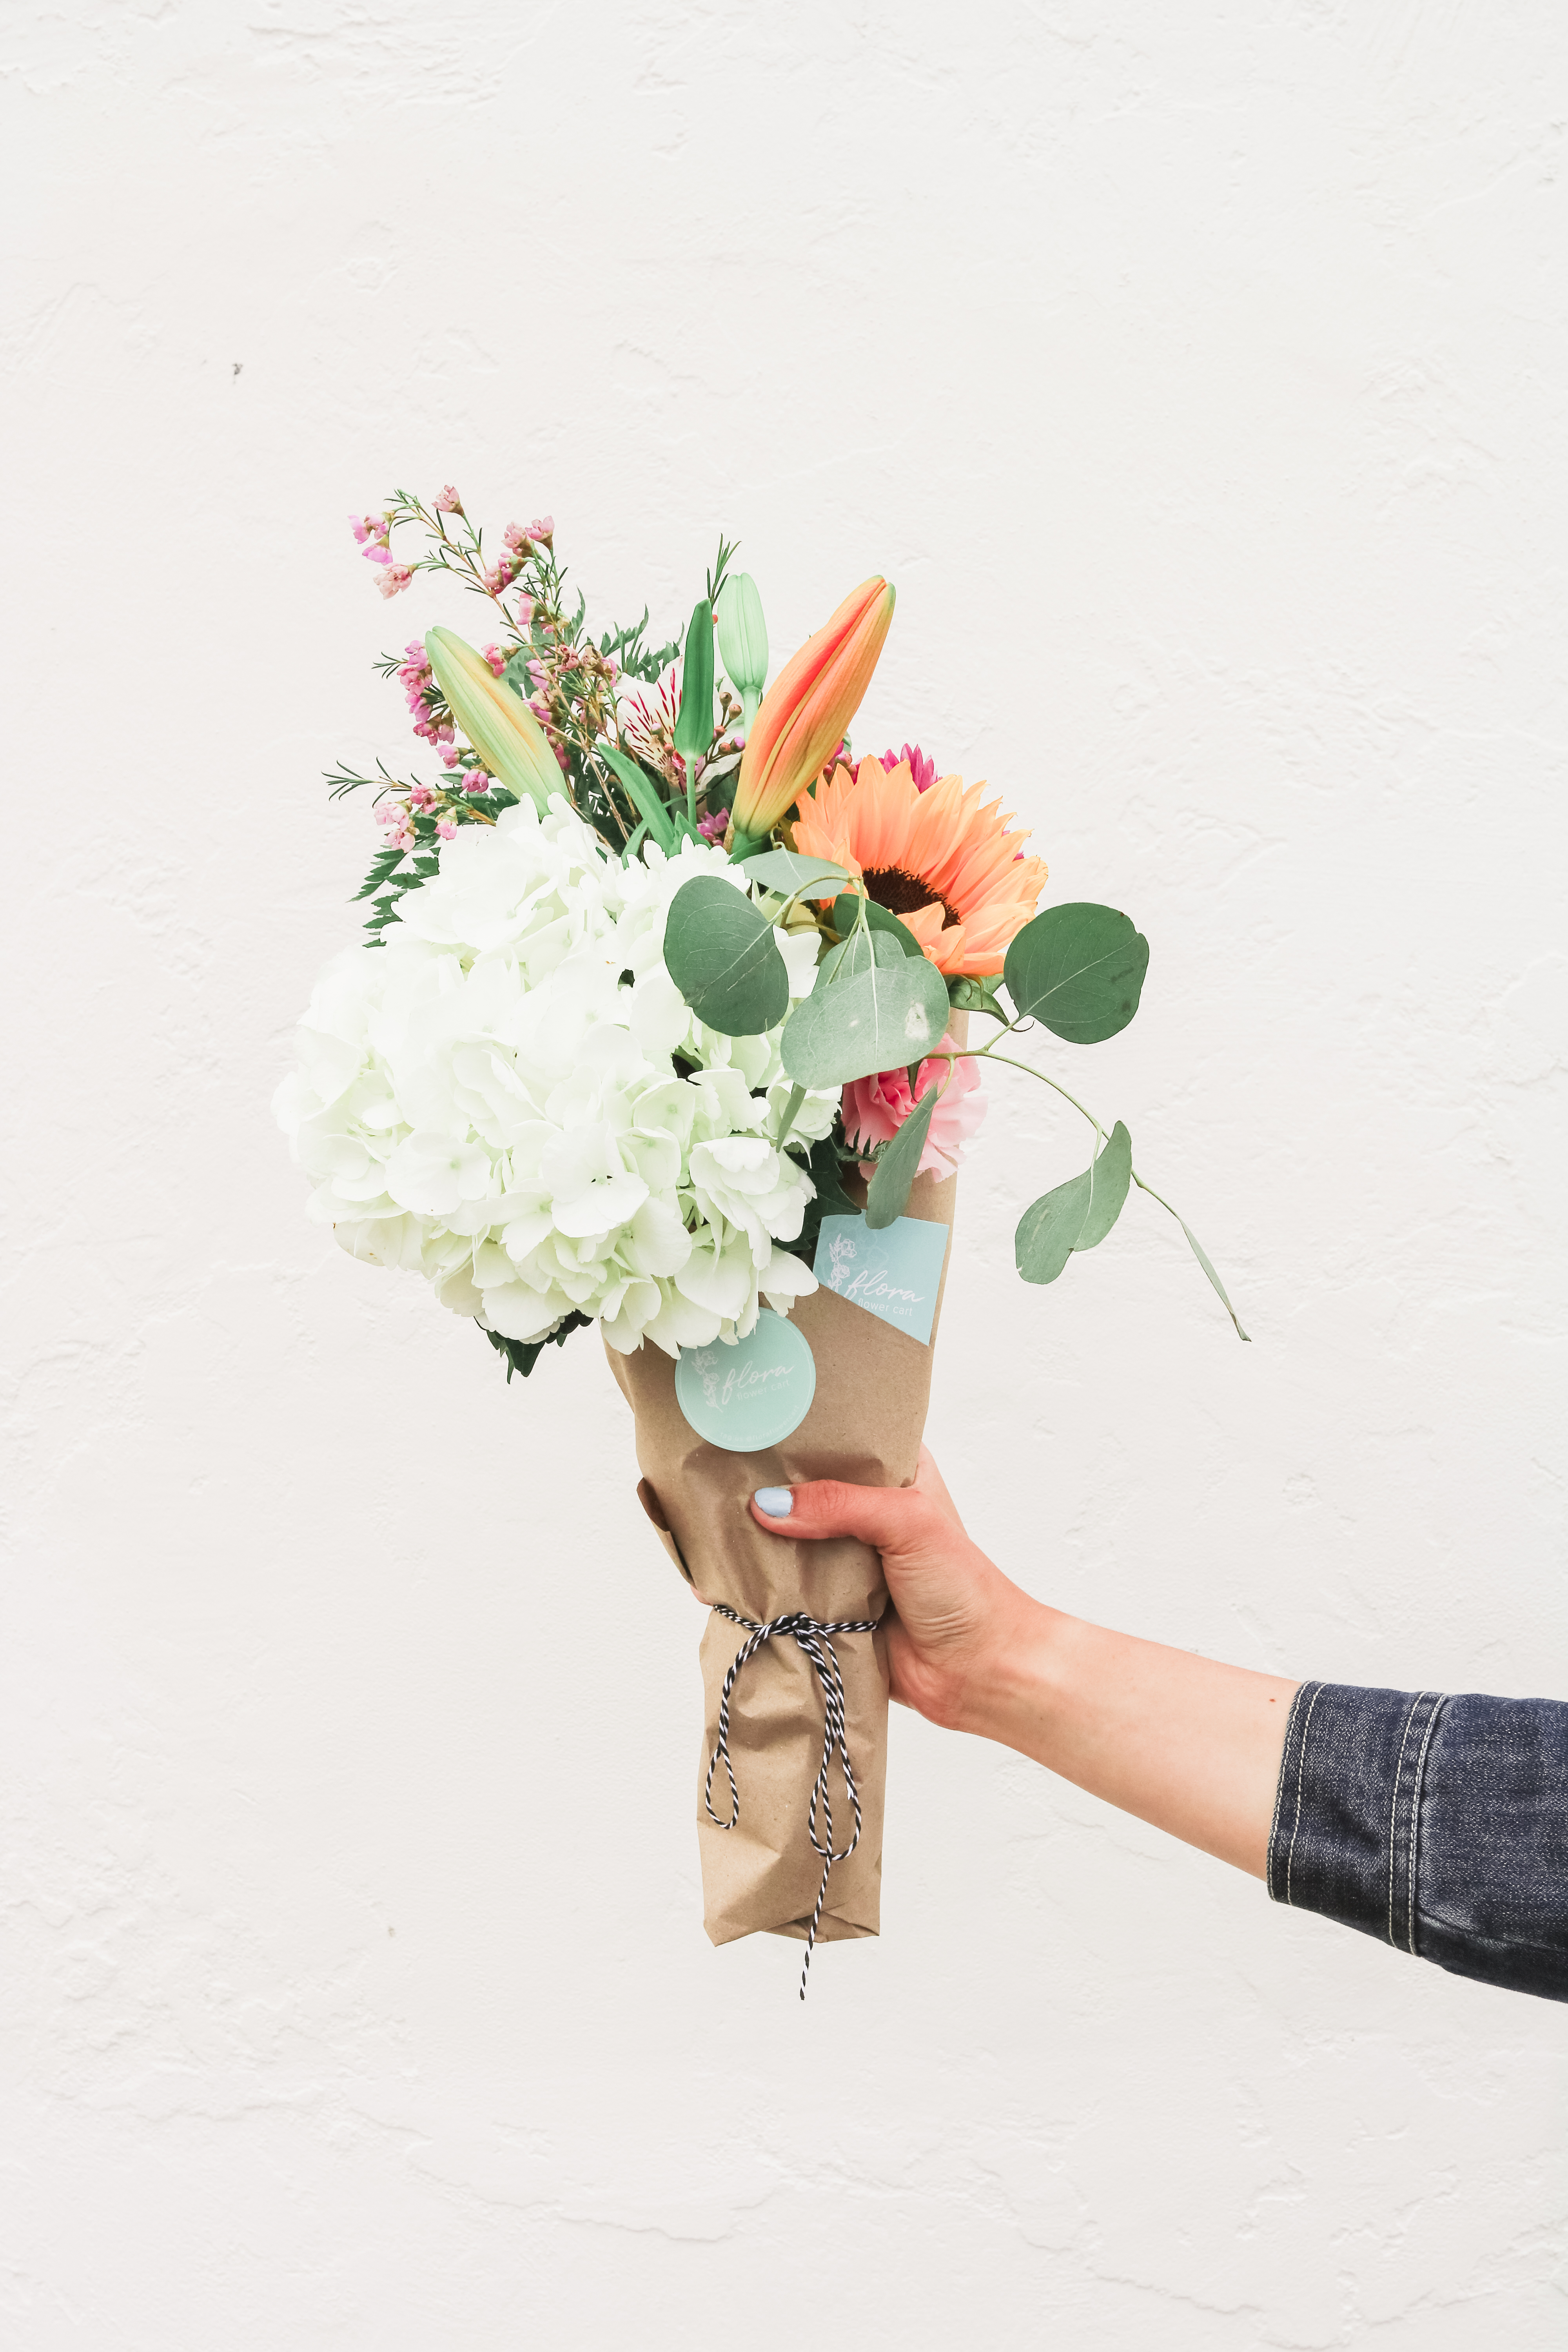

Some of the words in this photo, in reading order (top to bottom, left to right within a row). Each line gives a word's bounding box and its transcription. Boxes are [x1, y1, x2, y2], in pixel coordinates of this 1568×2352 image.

[844, 1270, 926, 1302] flora
[858, 1298, 889, 1312] flower
[893, 1306, 913, 1316] cart
[722, 1361, 794, 1405] flora
[737, 1387, 767, 1401] flower
[771, 1379, 790, 1390] cart
[720, 1432, 732, 1441] tag
[746, 1405, 799, 1442] @floraflowercart
